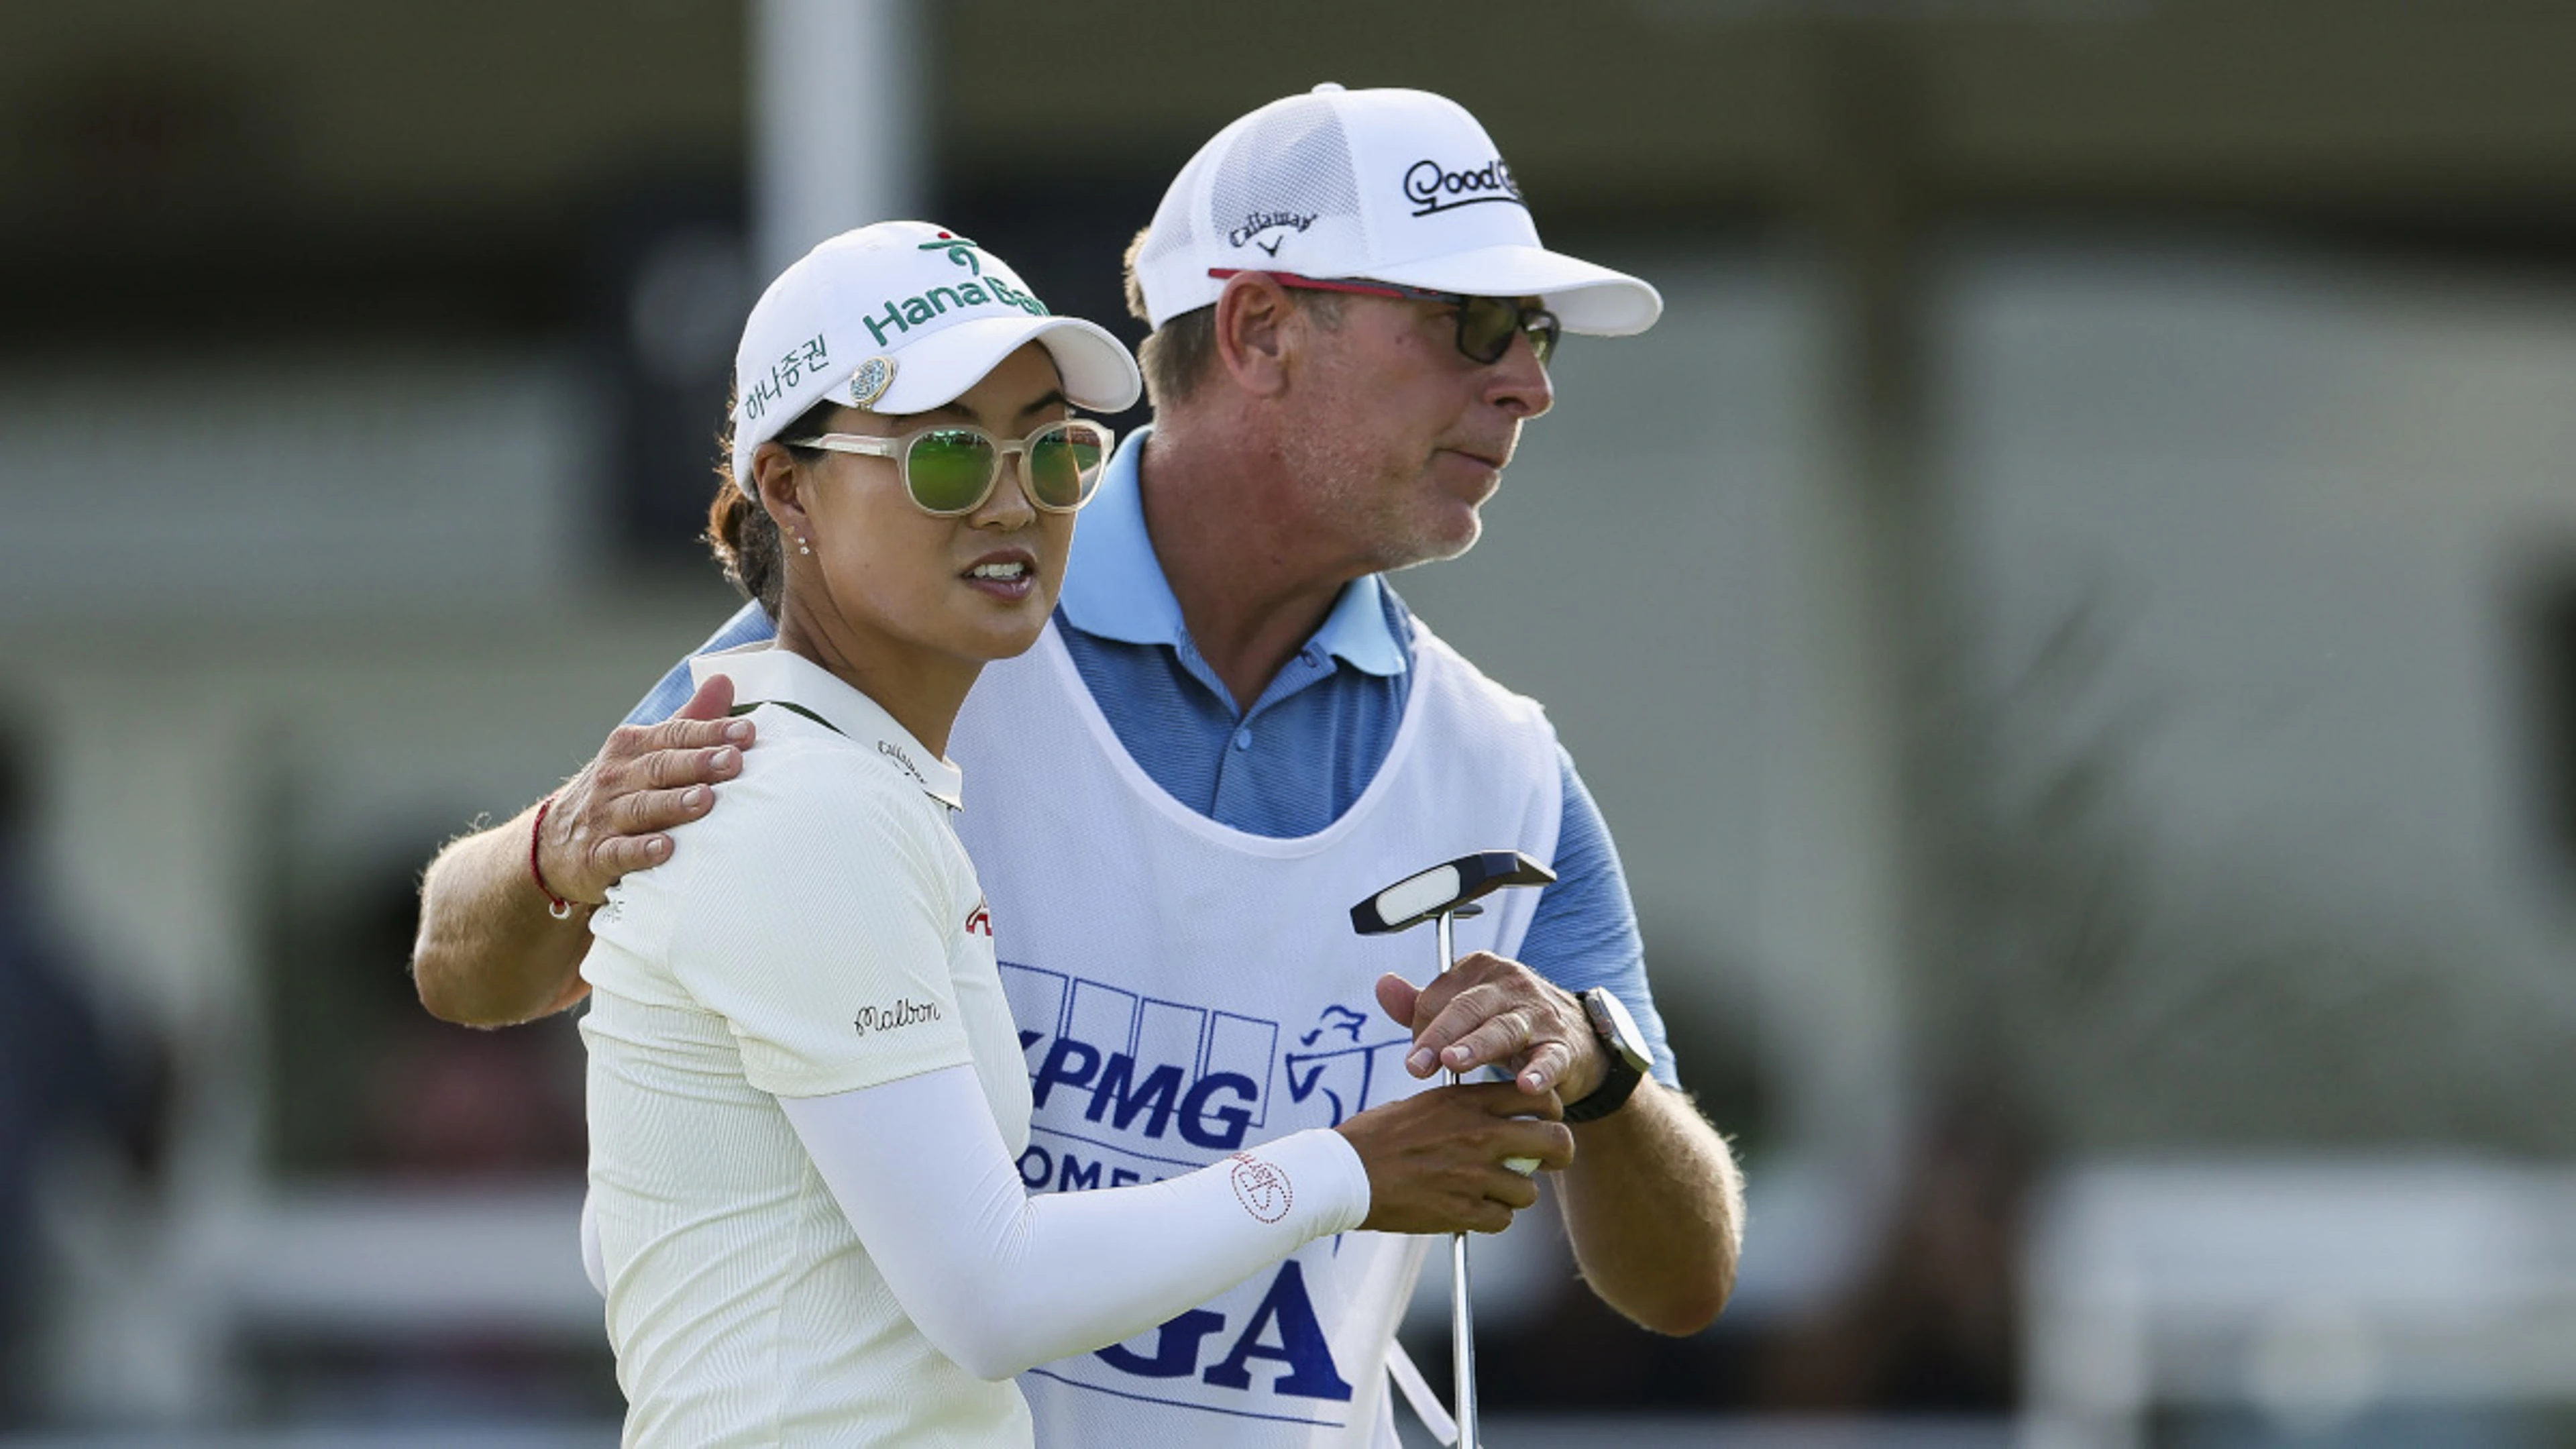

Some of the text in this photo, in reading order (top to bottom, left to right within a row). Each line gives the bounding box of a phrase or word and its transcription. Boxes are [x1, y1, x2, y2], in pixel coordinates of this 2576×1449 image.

[1230, 211, 1318, 248] Callaway
[863, 276, 1051, 347] Hana Ban
[745, 333, 829, 419] 하나증권
[853, 998, 941, 1037] Malbon
[1093, 1259, 1353, 1401] GA
